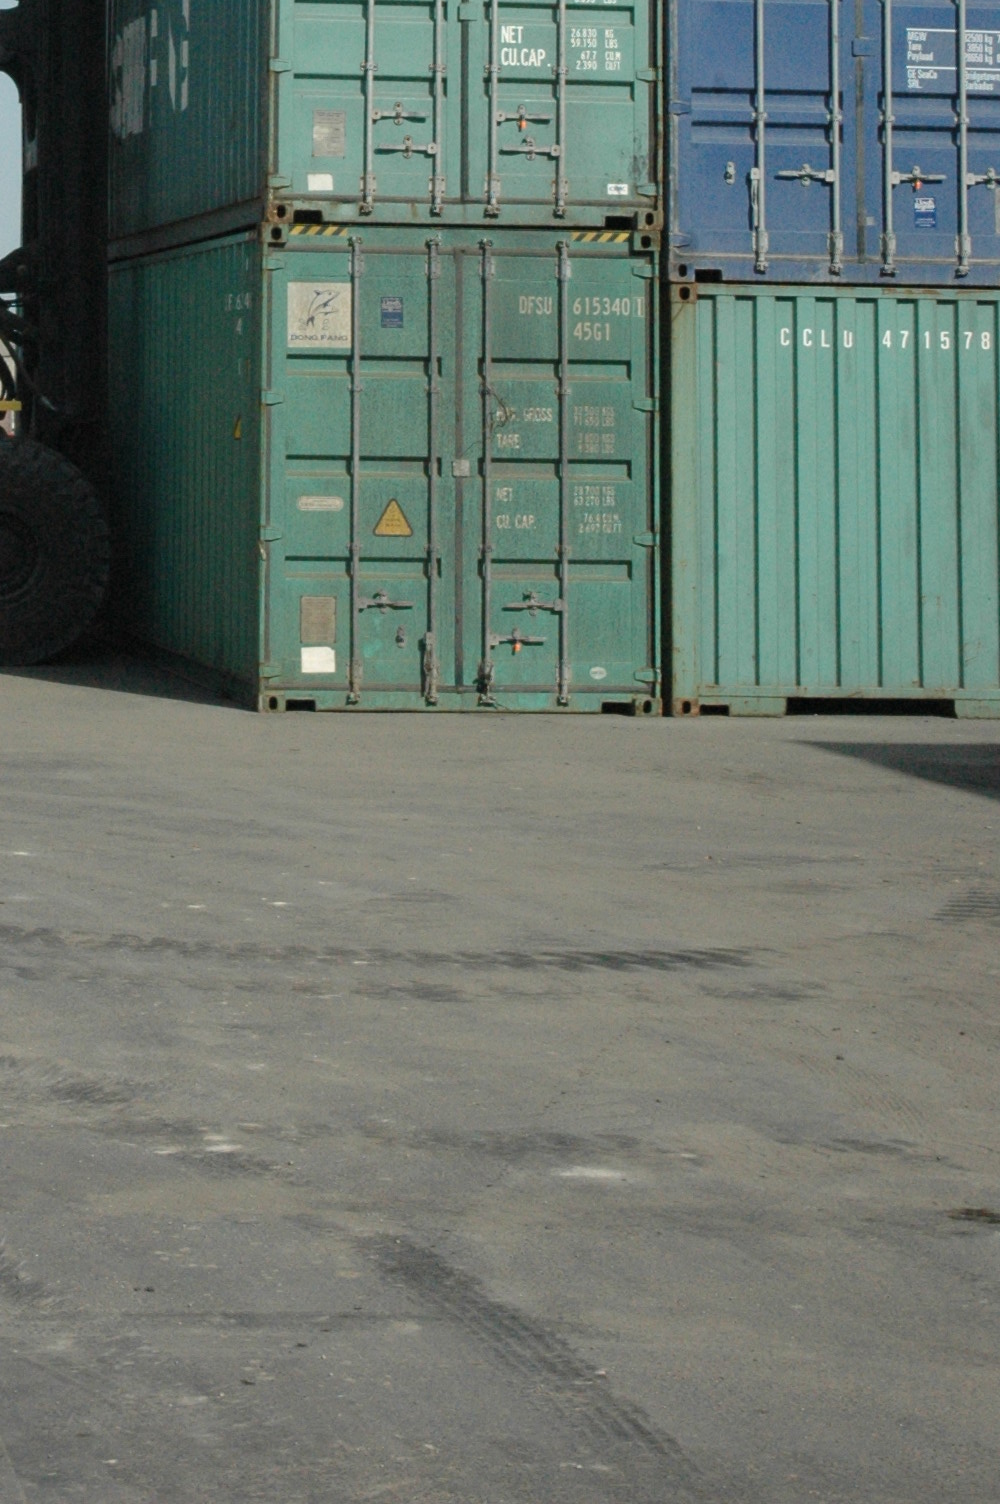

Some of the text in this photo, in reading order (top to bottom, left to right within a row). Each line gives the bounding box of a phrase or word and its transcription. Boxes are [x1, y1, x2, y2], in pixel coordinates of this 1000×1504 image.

[501, 25, 523, 44] NET
[519, 296, 552, 314] DFSU
[573, 297, 630, 315] 615340
[573, 322, 610, 341] 45G1
[780, 328, 991, 350] CCLU 471578
[496, 434, 520, 449] TARE
[496, 487, 513, 502] NET
